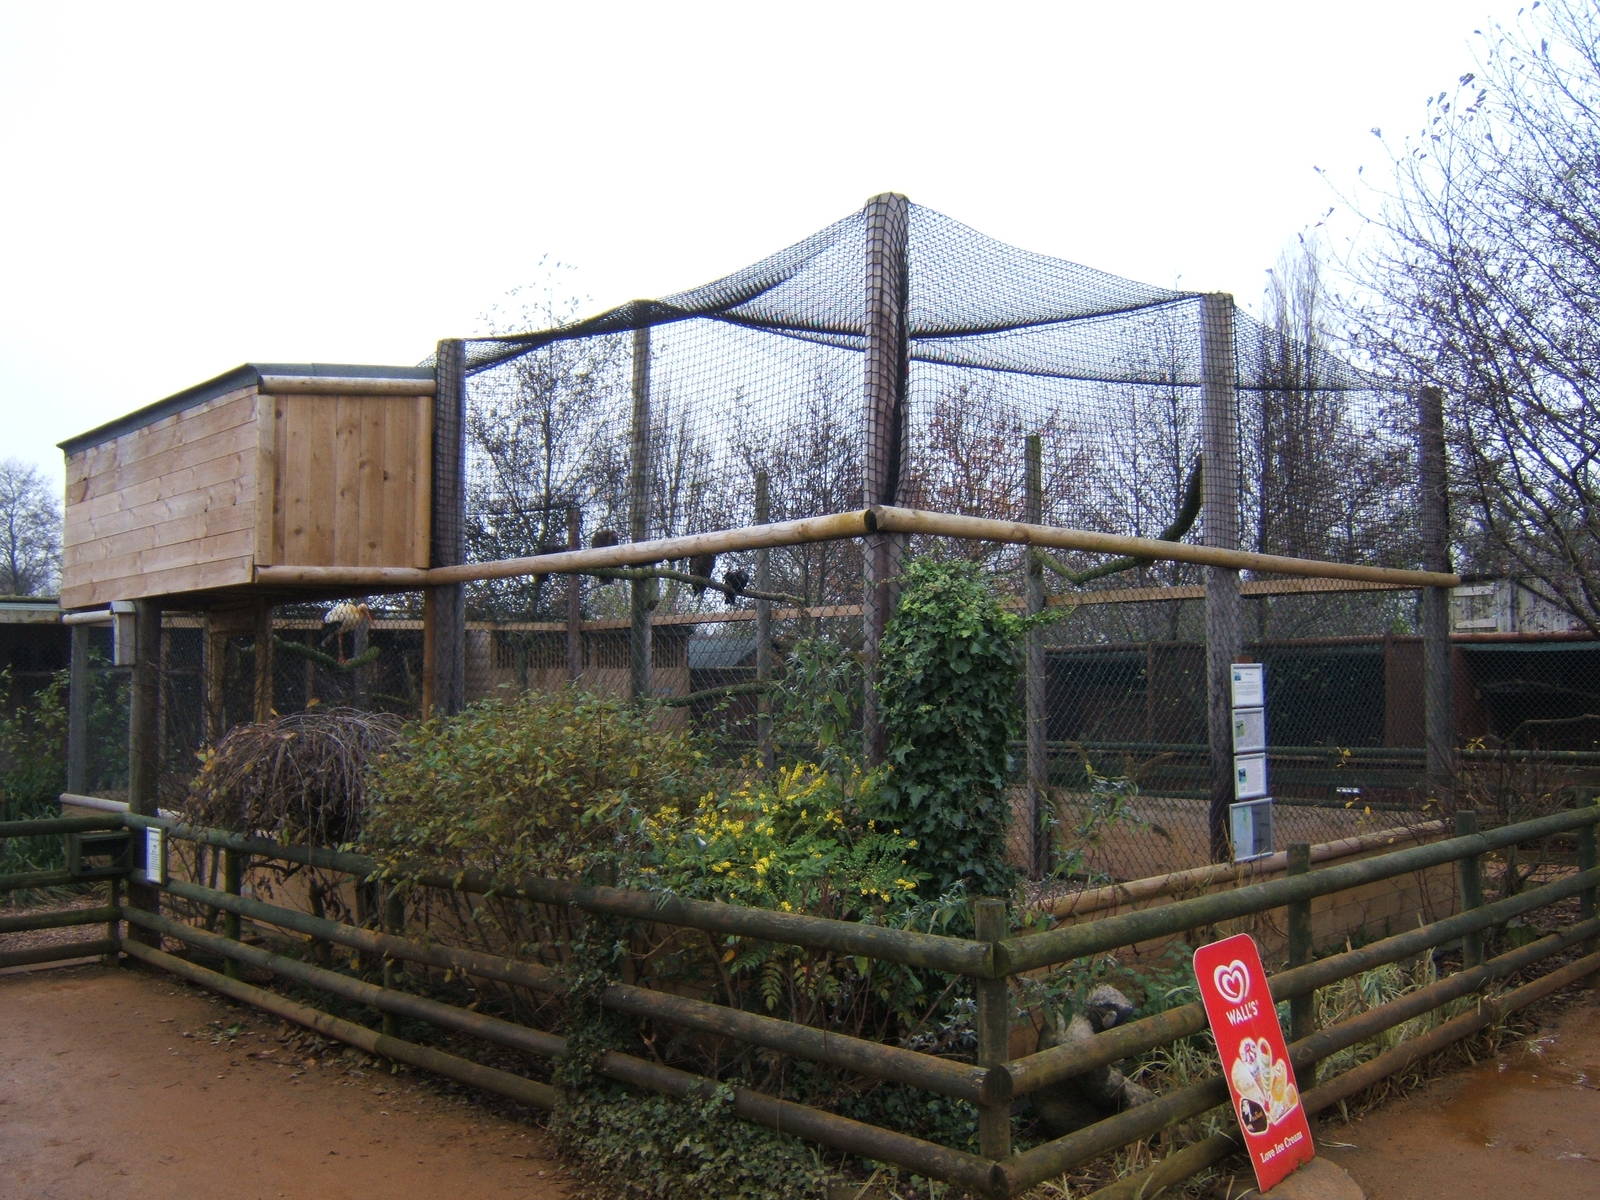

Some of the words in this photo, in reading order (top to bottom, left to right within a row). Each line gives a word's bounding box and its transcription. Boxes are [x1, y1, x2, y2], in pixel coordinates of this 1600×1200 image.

[1225, 1000, 1258, 1026] WALL'S
[1259, 1149, 1276, 1163] Love
[1274, 1142, 1285, 1154] Ice
[1283, 1131, 1303, 1148] Cream
